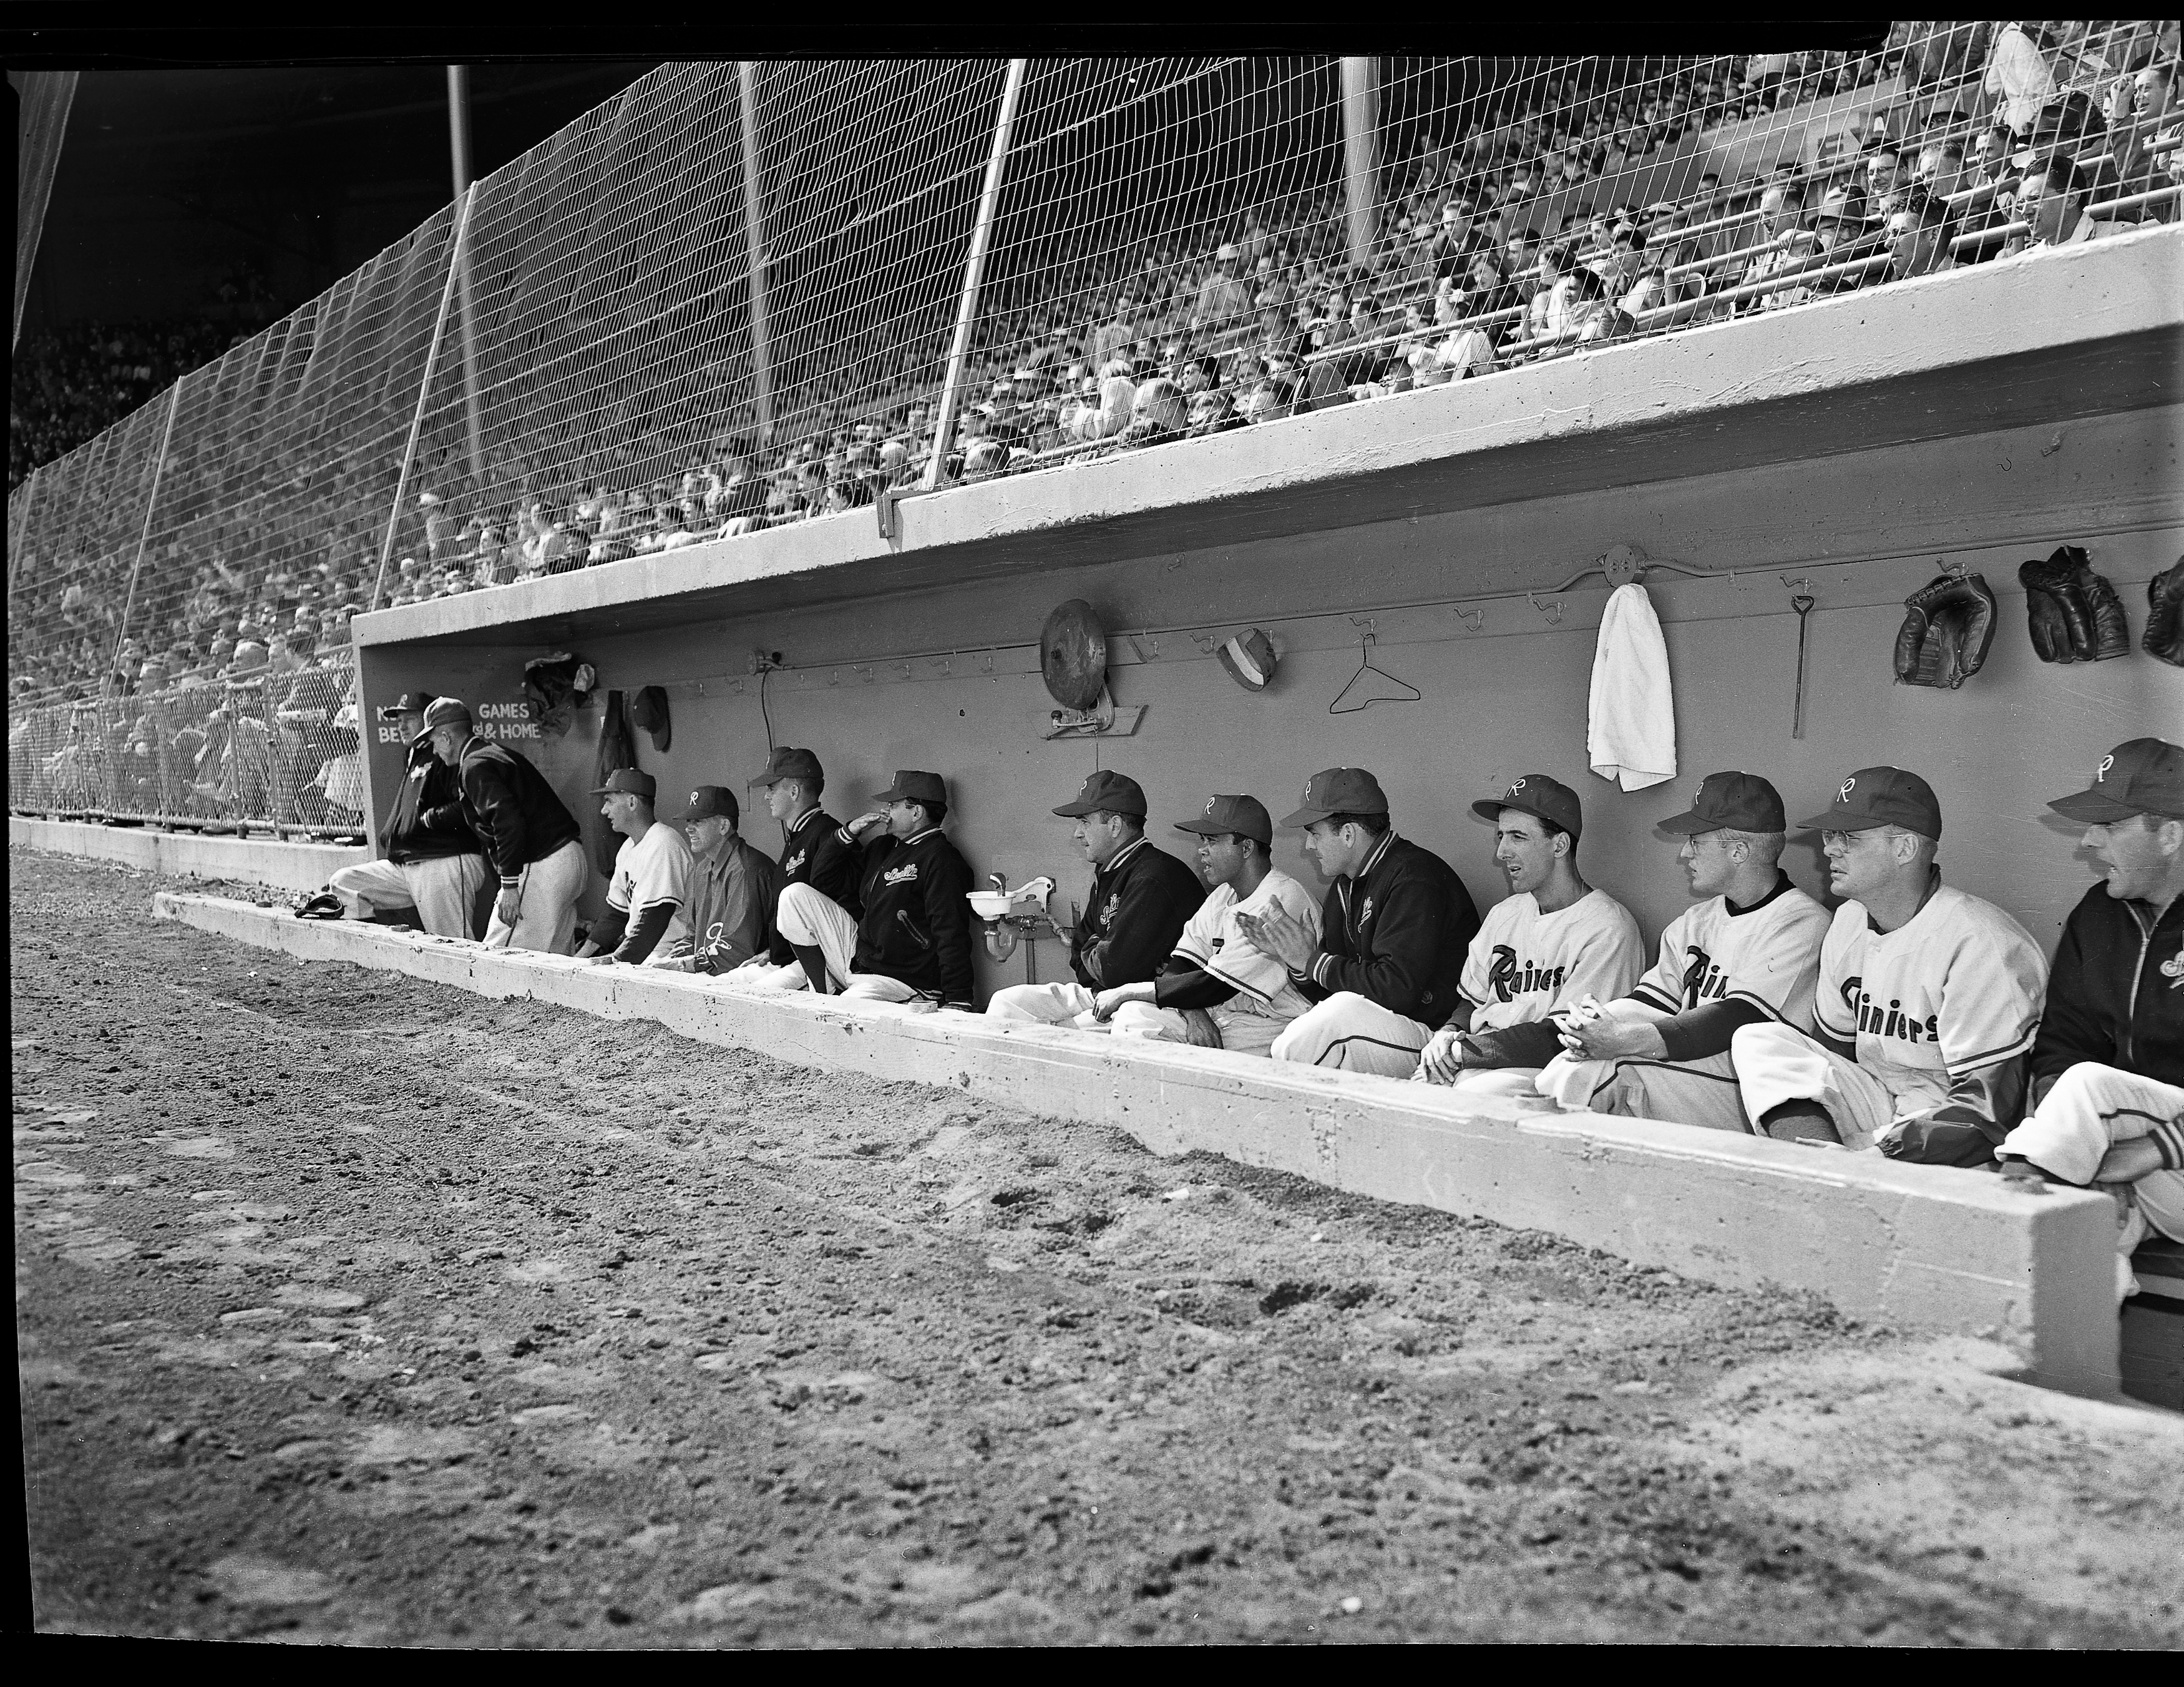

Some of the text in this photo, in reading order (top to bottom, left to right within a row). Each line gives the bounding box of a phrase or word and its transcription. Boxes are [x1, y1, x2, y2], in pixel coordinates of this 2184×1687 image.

[478, 703, 530, 719] GAMES
[500, 724, 542, 739] HOME
[1506, 779, 1526, 798] R
[1836, 777, 1856, 803] R
[690, 791, 699, 806] R
[1204, 797, 1216, 815] R
